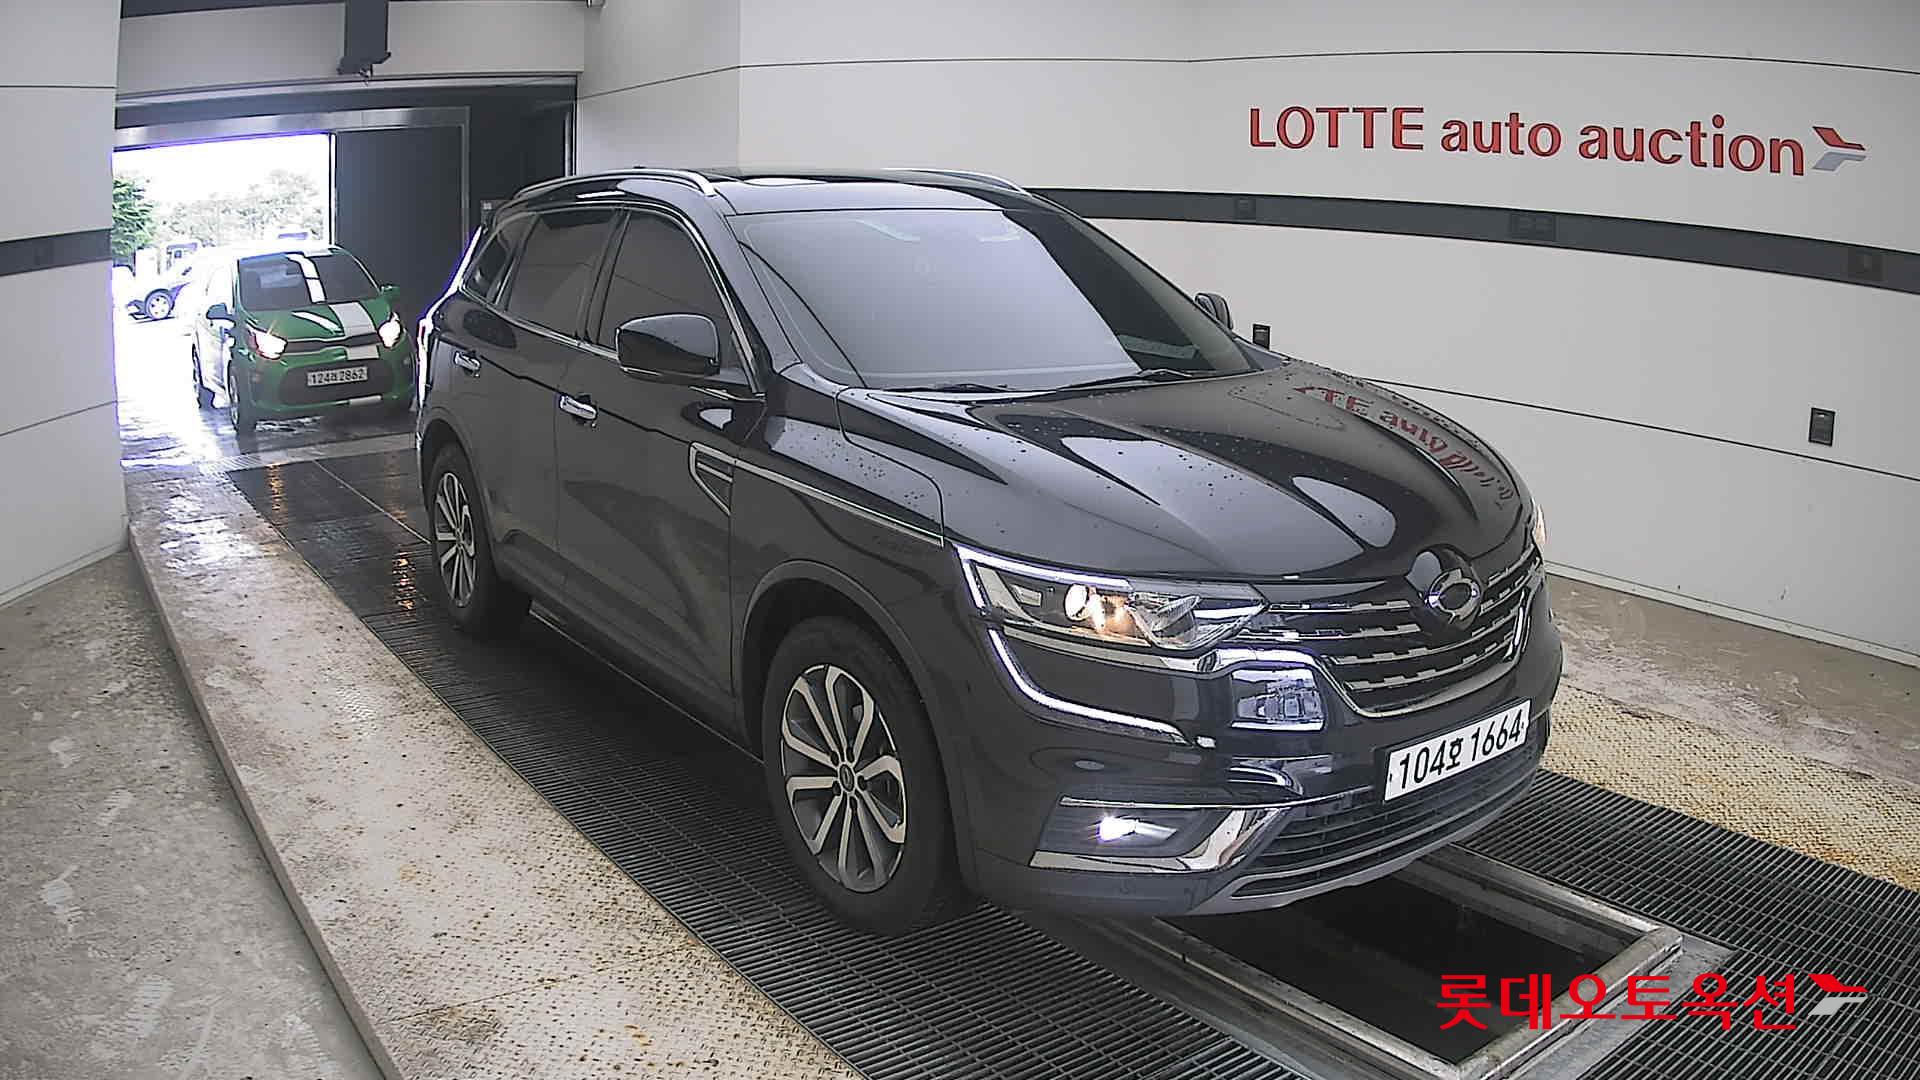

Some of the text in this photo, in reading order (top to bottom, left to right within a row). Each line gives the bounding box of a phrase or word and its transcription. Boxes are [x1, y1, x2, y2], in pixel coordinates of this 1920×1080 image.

[1249, 106, 1806, 176] LOTTE auto auction
[1471, 708, 1522, 762] 1664
